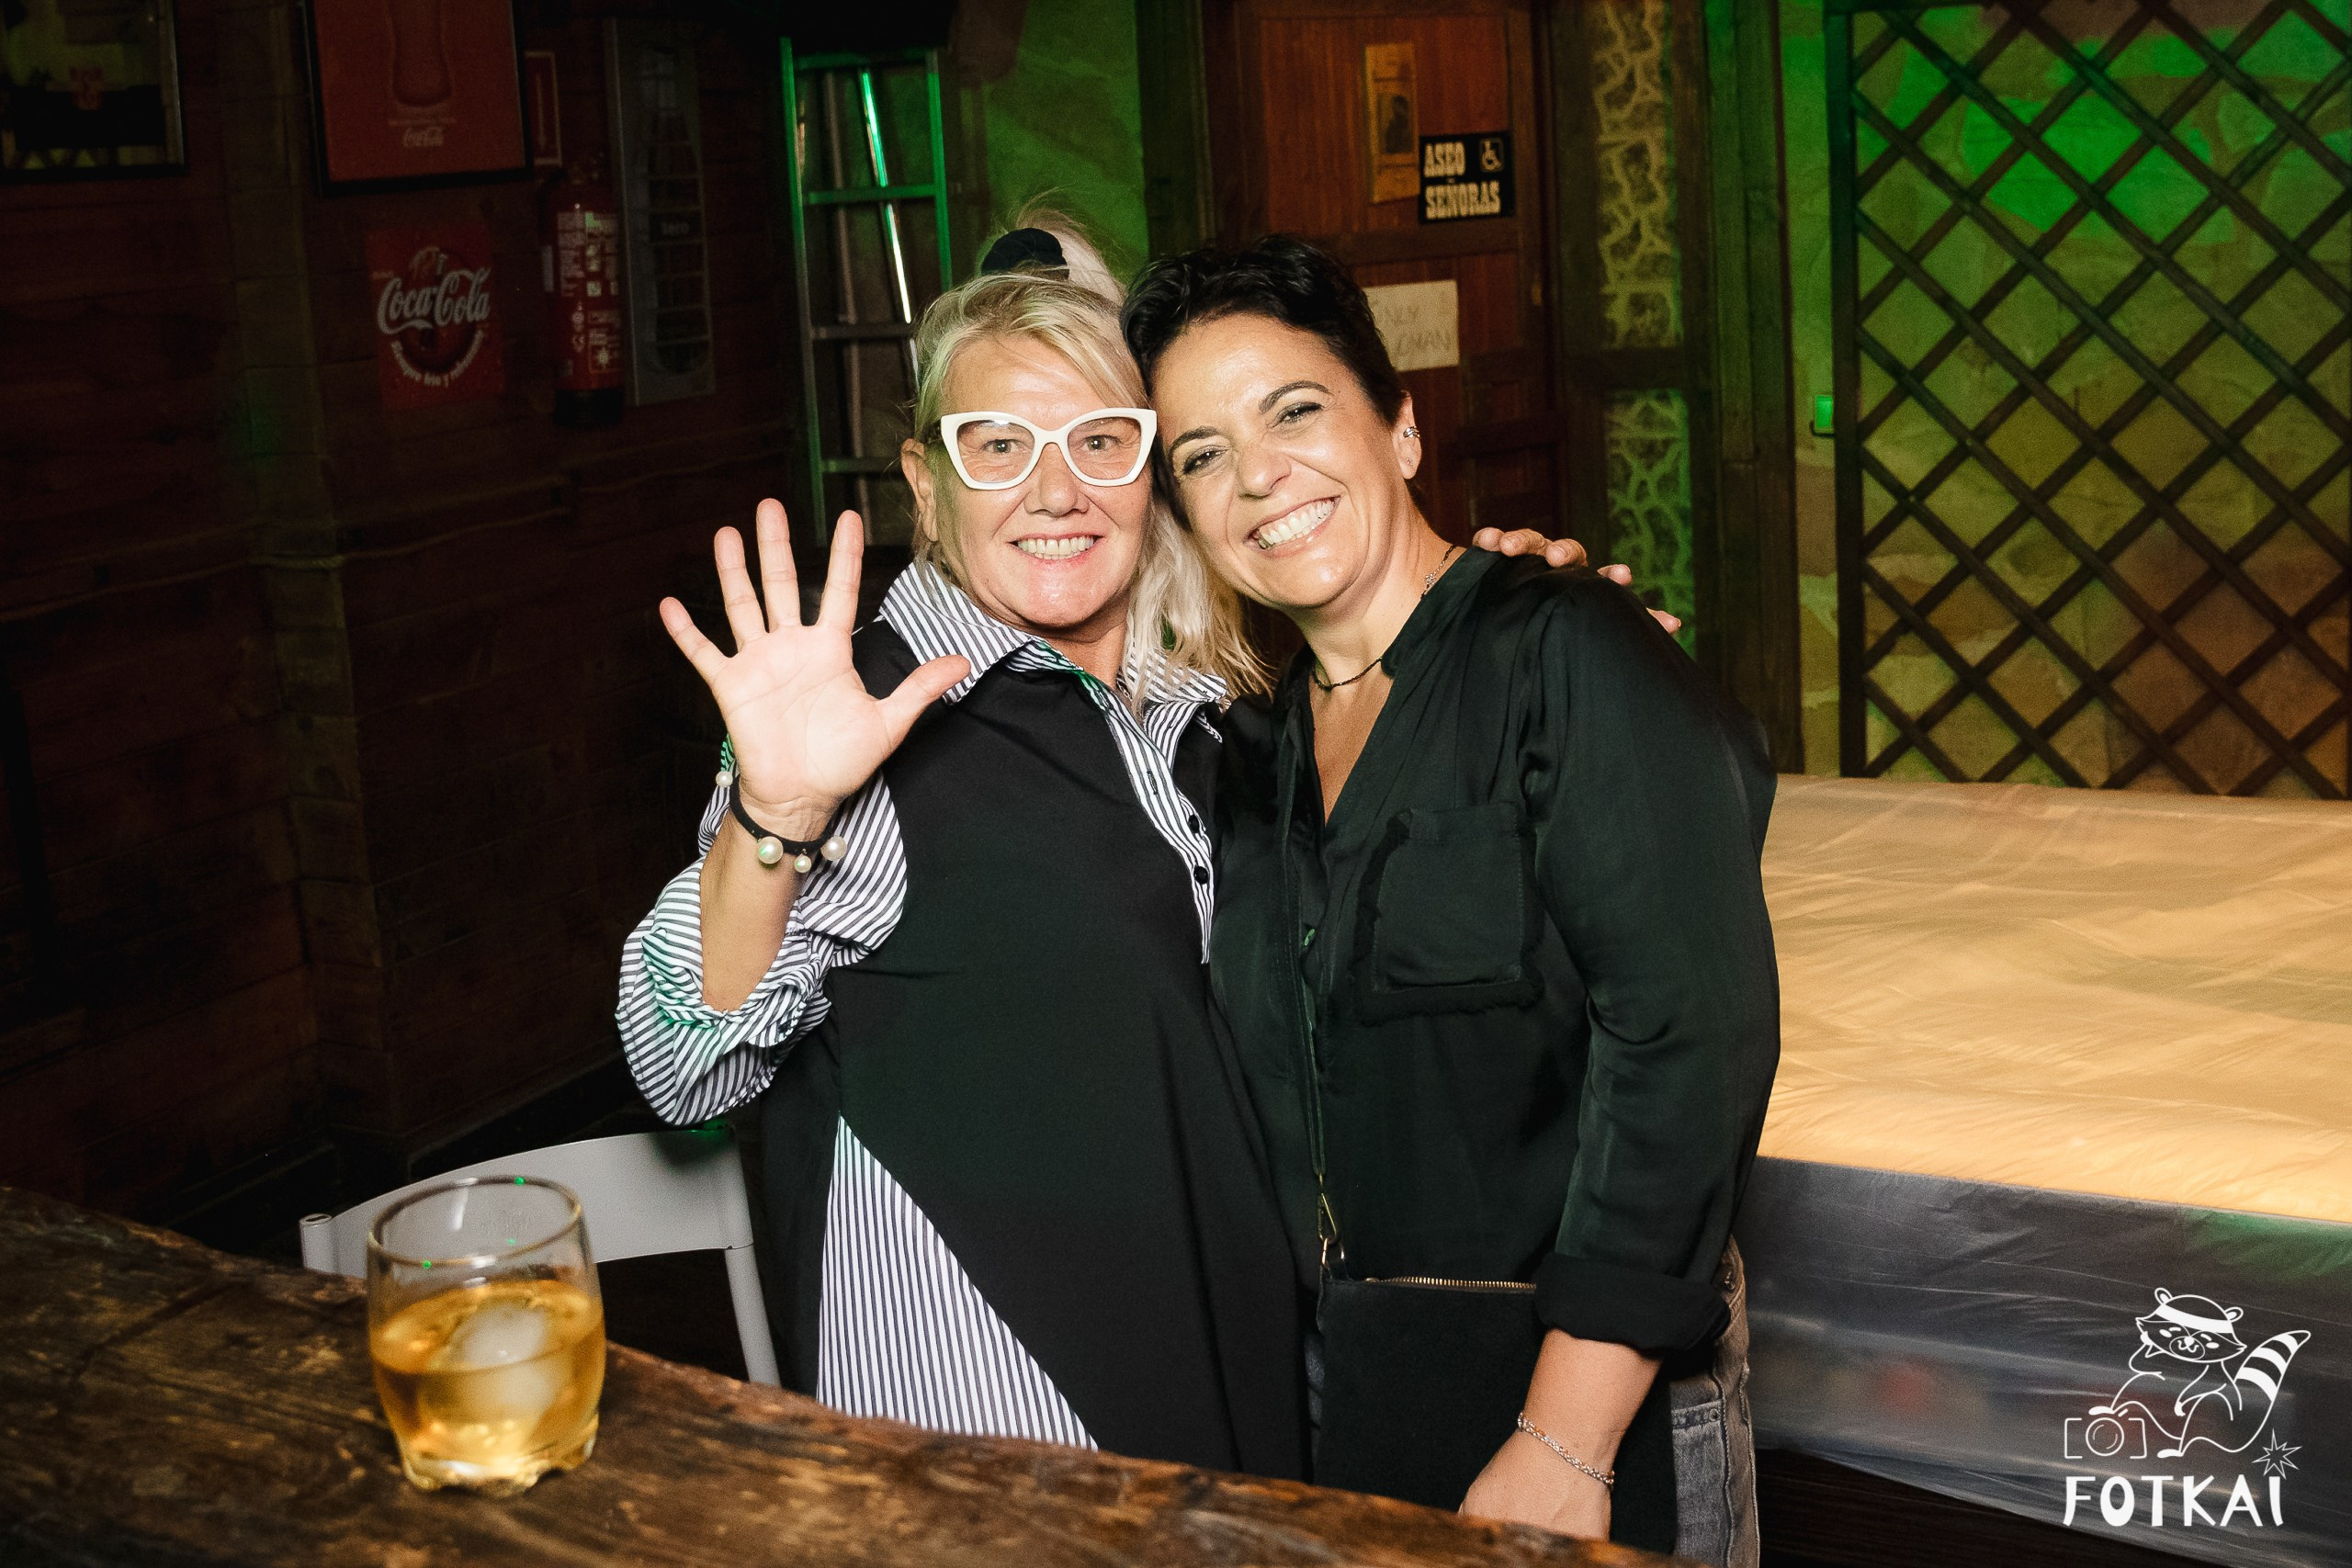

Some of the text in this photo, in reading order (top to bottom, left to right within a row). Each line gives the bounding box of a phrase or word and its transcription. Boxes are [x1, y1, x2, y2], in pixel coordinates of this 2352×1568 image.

[1424, 141, 1465, 177] ASEO
[1425, 178, 1501, 220] SEÑORAS
[377, 266, 492, 334] Coca-Cola
